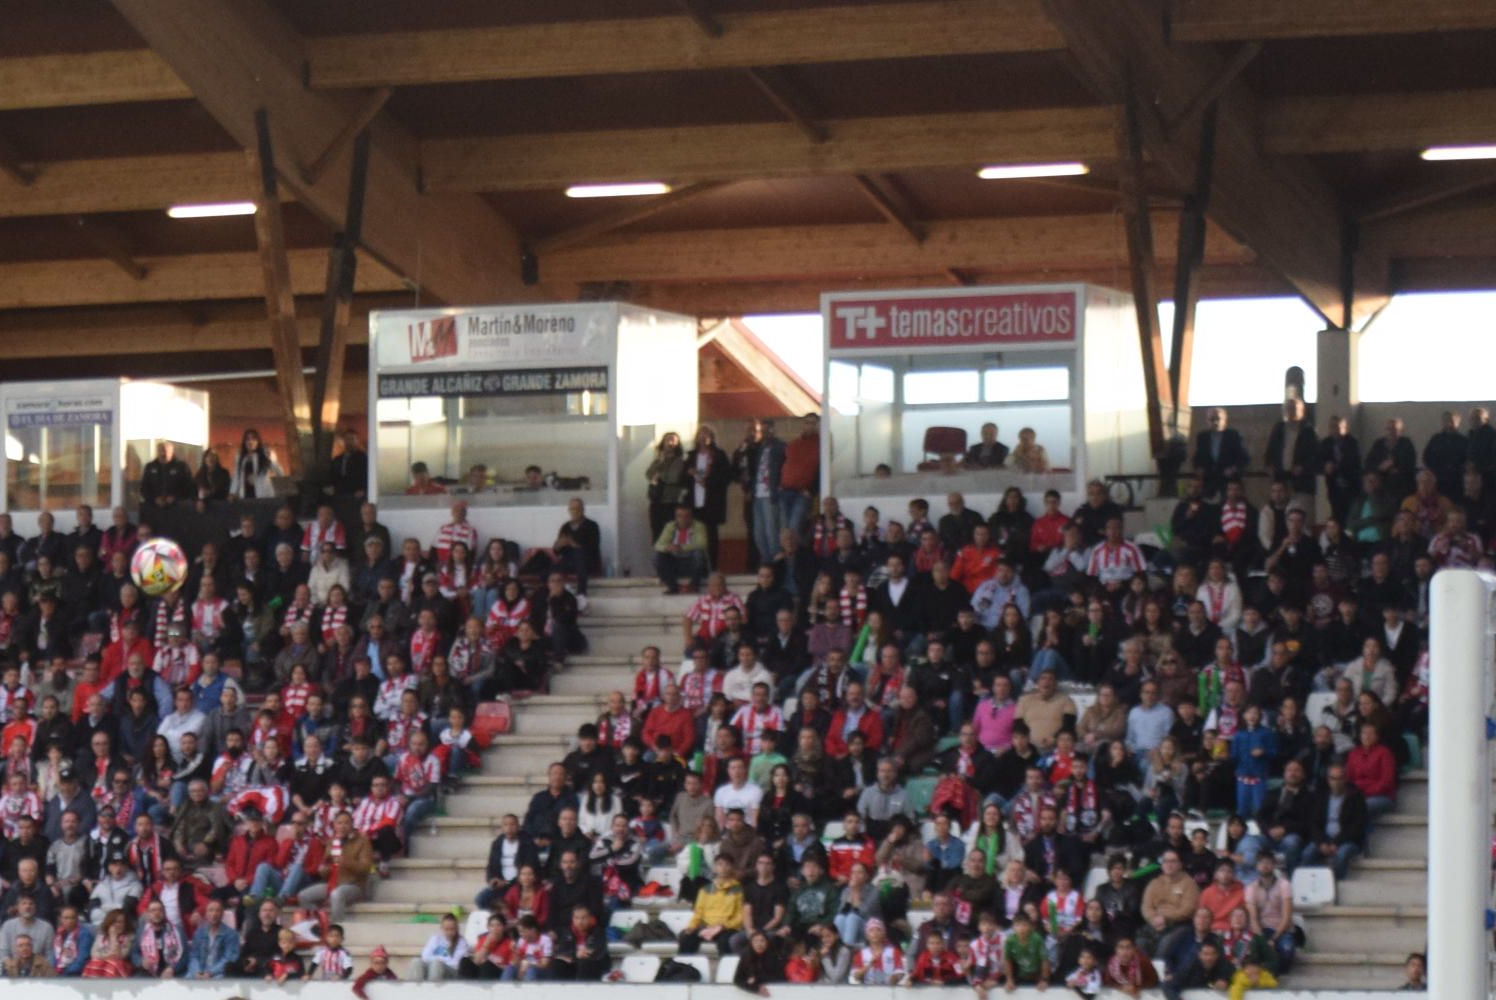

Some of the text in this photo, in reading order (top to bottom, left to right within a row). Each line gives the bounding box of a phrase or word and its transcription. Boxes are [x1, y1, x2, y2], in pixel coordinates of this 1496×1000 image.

[889, 302, 1071, 338] temascreativos
[380, 376, 429, 396] GRANDE
[503, 372, 551, 390] GRANDE
[554, 370, 607, 388] ZAMORA
